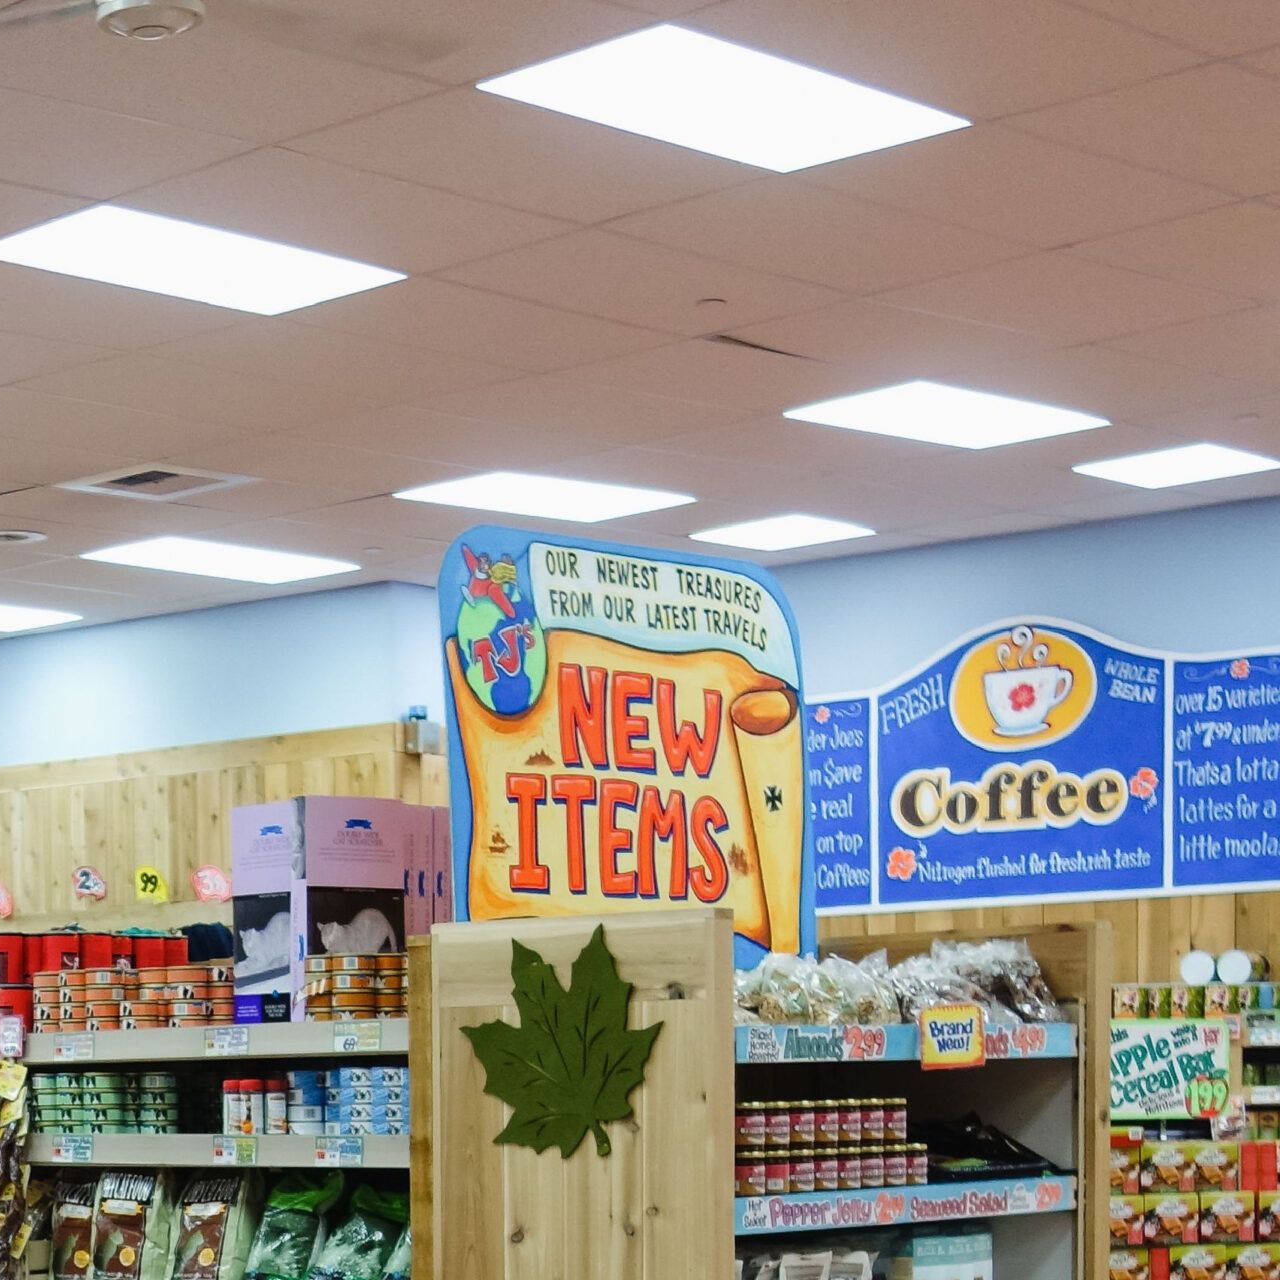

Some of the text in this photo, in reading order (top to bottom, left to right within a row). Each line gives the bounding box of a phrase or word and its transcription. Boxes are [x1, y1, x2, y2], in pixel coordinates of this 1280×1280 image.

[546, 550, 762, 614] OUR NEWEST TREASURES
[549, 589, 768, 652] FROM OUR LATEST TRAVELS
[1104, 657, 1160, 685] WHOLE
[879, 673, 947, 736] FRESH
[1108, 679, 1157, 704] BEAN
[1175, 692, 1206, 715] over
[1205, 685, 1223, 712] 15
[558, 662, 722, 778] NEW
[1175, 722, 1193, 752] at
[1236, 755, 1280, 783] lotta
[821, 792, 853, 821] real
[896, 766, 1125, 830] Coffee
[1179, 792, 1277, 824] lattes for a
[506, 772, 730, 903] ITEMS
[816, 830, 863, 856] on top
[1179, 833, 1220, 863] little
[818, 862, 870, 889] Coffees
[919, 860, 976, 885] Nitrogen
[976, 853, 1026, 879] flushed
[1028, 852, 1047, 876] for
[1114, 847, 1151, 869] taste
[929, 1018, 973, 1038] Brand
[783, 1027, 845, 1061] Almonds
[937, 1036, 970, 1053] New!
[1110, 1048, 1216, 1109] Cereal Bar
[748, 1199, 763, 1211] Hot
[769, 1196, 872, 1230] Pepper Jelly
[910, 1190, 968, 1221] Seaweed
[968, 1188, 1009, 1214] Salad
